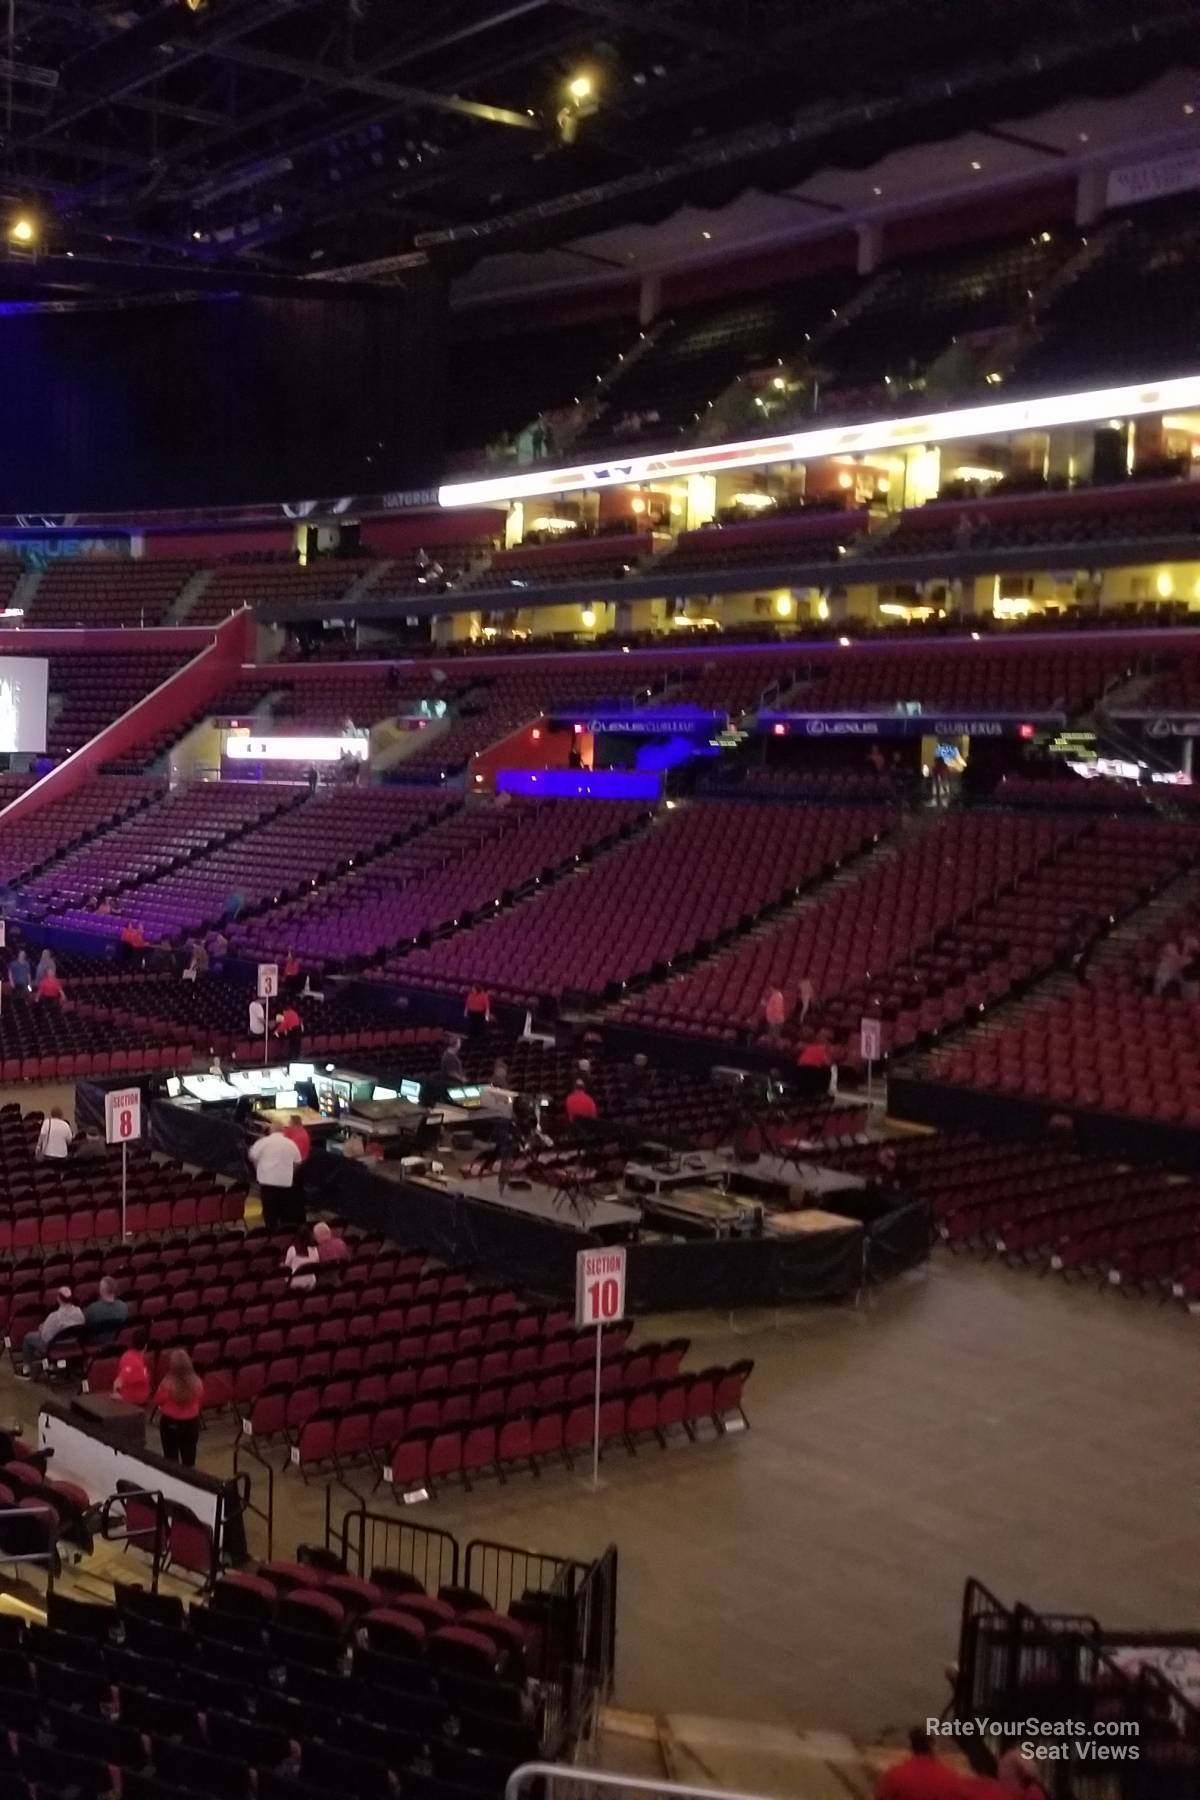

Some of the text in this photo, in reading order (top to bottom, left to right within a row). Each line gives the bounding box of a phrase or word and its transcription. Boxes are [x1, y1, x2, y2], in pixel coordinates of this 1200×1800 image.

[825, 722, 878, 734] LEXUS
[264, 976, 272, 994] 3
[113, 1093, 138, 1108] SECTION
[120, 1110, 132, 1138] 8
[585, 1256, 620, 1275] SECTION
[588, 1280, 618, 1319] 10
